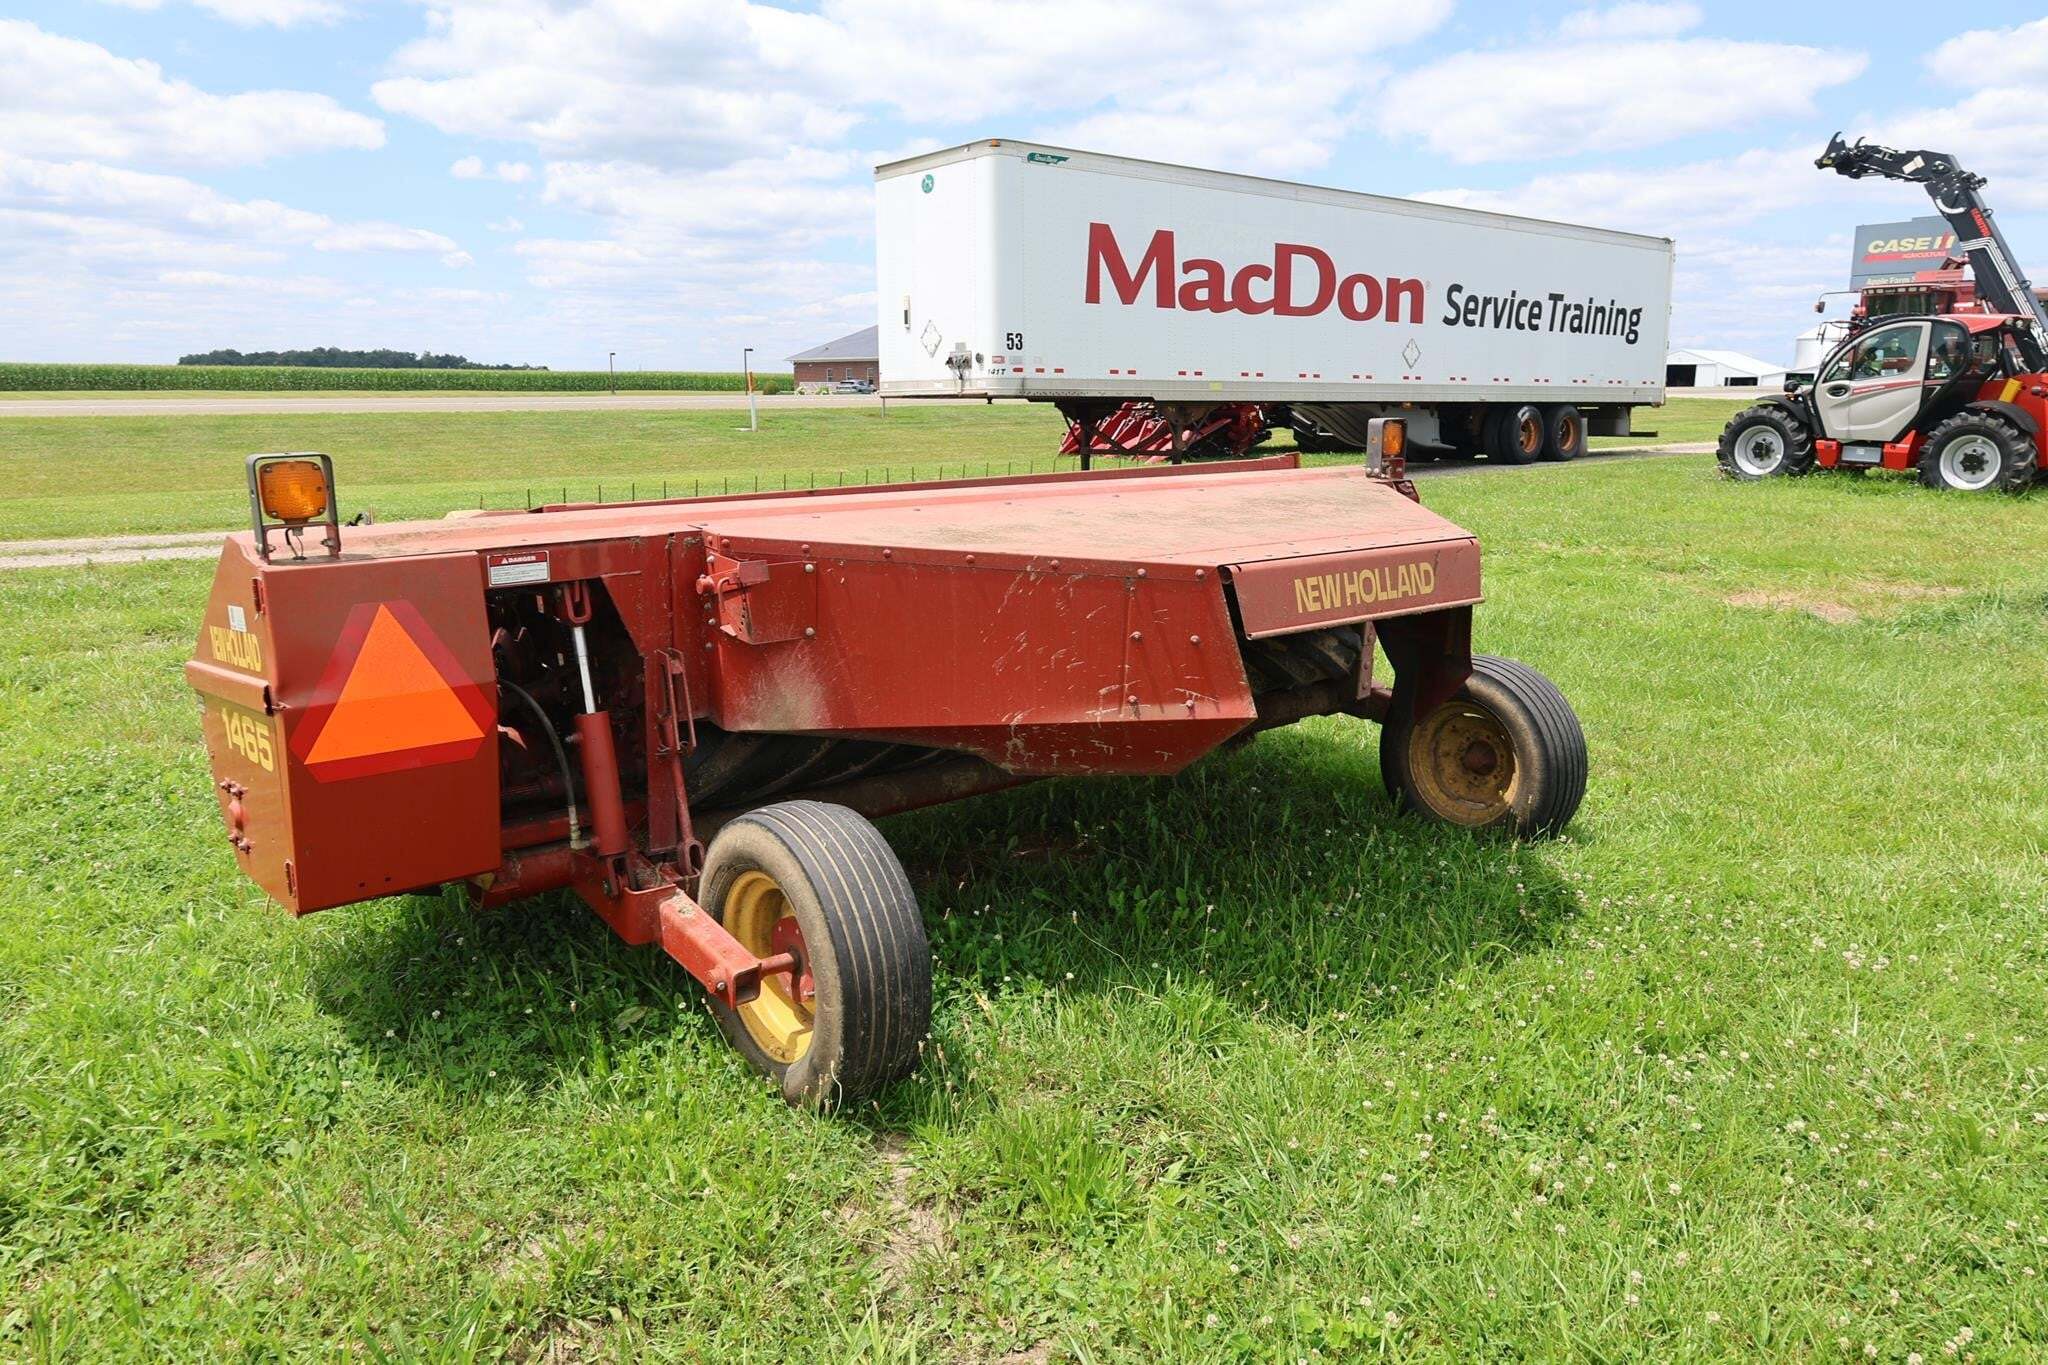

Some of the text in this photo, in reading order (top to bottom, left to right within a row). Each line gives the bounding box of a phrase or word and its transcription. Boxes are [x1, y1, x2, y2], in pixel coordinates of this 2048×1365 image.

[1867, 236, 1931, 254] CASE
[1085, 222, 1643, 345] MacDon Service Training
[1006, 332, 1024, 350] 53
[1294, 562, 1435, 614] NEW HOLLAND
[221, 705, 274, 773] 1465
